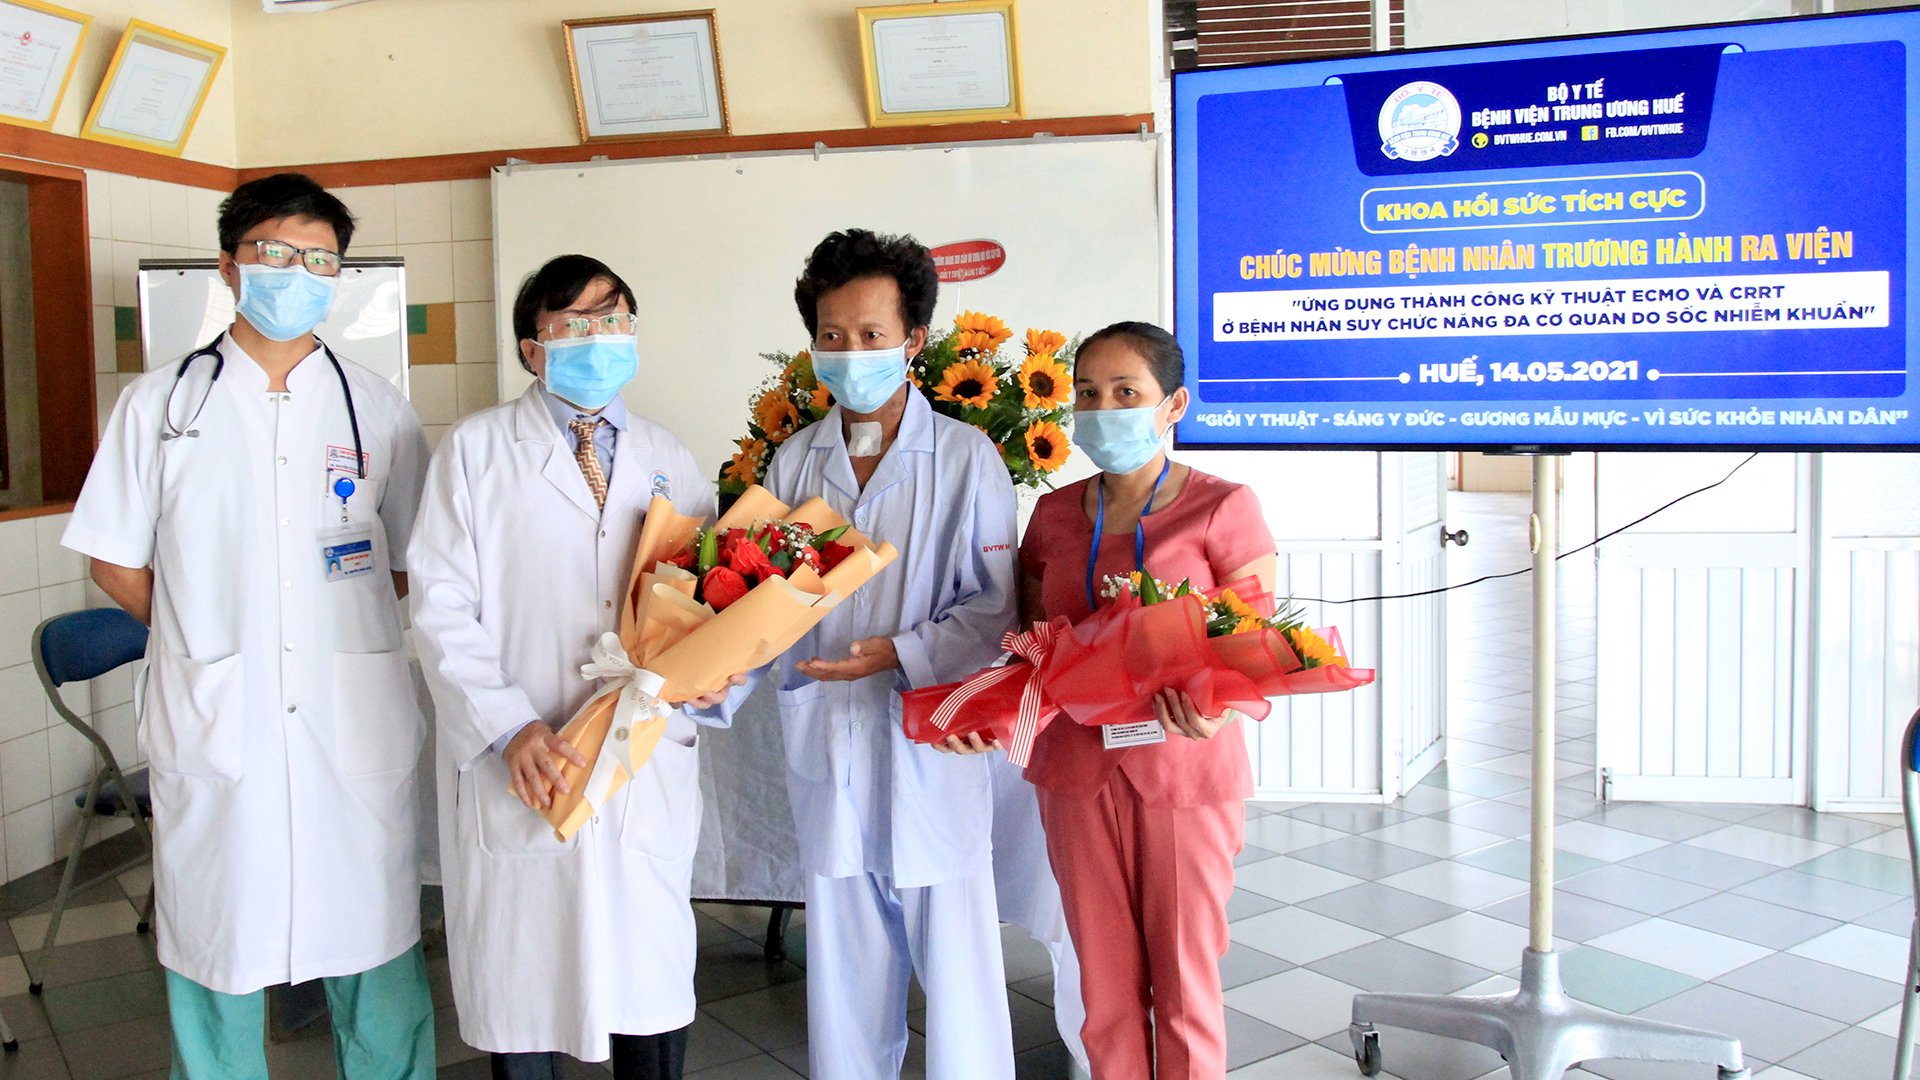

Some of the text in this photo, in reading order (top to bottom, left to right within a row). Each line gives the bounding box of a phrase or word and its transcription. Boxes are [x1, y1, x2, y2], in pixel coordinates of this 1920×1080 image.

[1548, 78, 1604, 102] BỘ Y TẾ
[1472, 93, 1685, 129] BỆNH VIỆN TRUNG ƯƠNG HUẾ
[1494, 130, 1567, 145] BVTWHUE.COM.VN
[1606, 123, 1683, 138] FB.COM/BVTWHUE
[1377, 188, 1686, 221] KHOA HỒI SỨC TÍCH CỰC
[1240, 226, 1852, 280] CHÚC MỪNG BỆNH NHÂN TRƯƠNG HÀNH RA VIỆN
[1345, 298, 1395, 313] DỤNG
[1401, 293, 1465, 308] THÀNH
[1471, 291, 1524, 306] CÔNG
[1531, 290, 1555, 305] KỸ
[1563, 287, 1627, 307] THUẬT
[1633, 288, 1689, 302] ECMO
[1697, 284, 1723, 300] VÀ
[1730, 286, 1785, 299] CRRT
[1222, 319, 1234, 334] Ở
[1240, 319, 1285, 336] BỆNH
[1291, 317, 1341, 332] NHÂN
[1347, 318, 1381, 331] SUY
[1388, 314, 1437, 331] CHỨC
[1444, 314, 1497, 328] NĂNG
[1504, 315, 1530, 327] ĐA
[1537, 312, 1562, 326] CƠ
[1568, 312, 1626, 326] QUAN
[1633, 312, 1660, 324] DO
[1667, 304, 1707, 324] SỐC
[1715, 303, 1780, 322] NHIỄM
[1420, 355, 1638, 386] HUẾ, 14.05.2021
[1197, 410, 1240, 426] “GIỎI
[1245, 413, 1258, 426] Y
[1260, 410, 1319, 429] THUẬT
[1333, 410, 1384, 426] SÁNG
[1388, 413, 1401, 426] Y
[1405, 409, 1445, 426] ĐỨC
[1461, 411, 1530, 426] GƯƠNG
[1535, 406, 1578, 425] MẪU
[1583, 410, 1627, 429] MỰC
[1644, 408, 1665, 425] VÌ
[1669, 408, 1711, 425] SỨC
[1716, 407, 1775, 425] KHỎE
[1780, 407, 1843, 425] NHÂN
[1849, 407, 1908, 424] DÂN”
